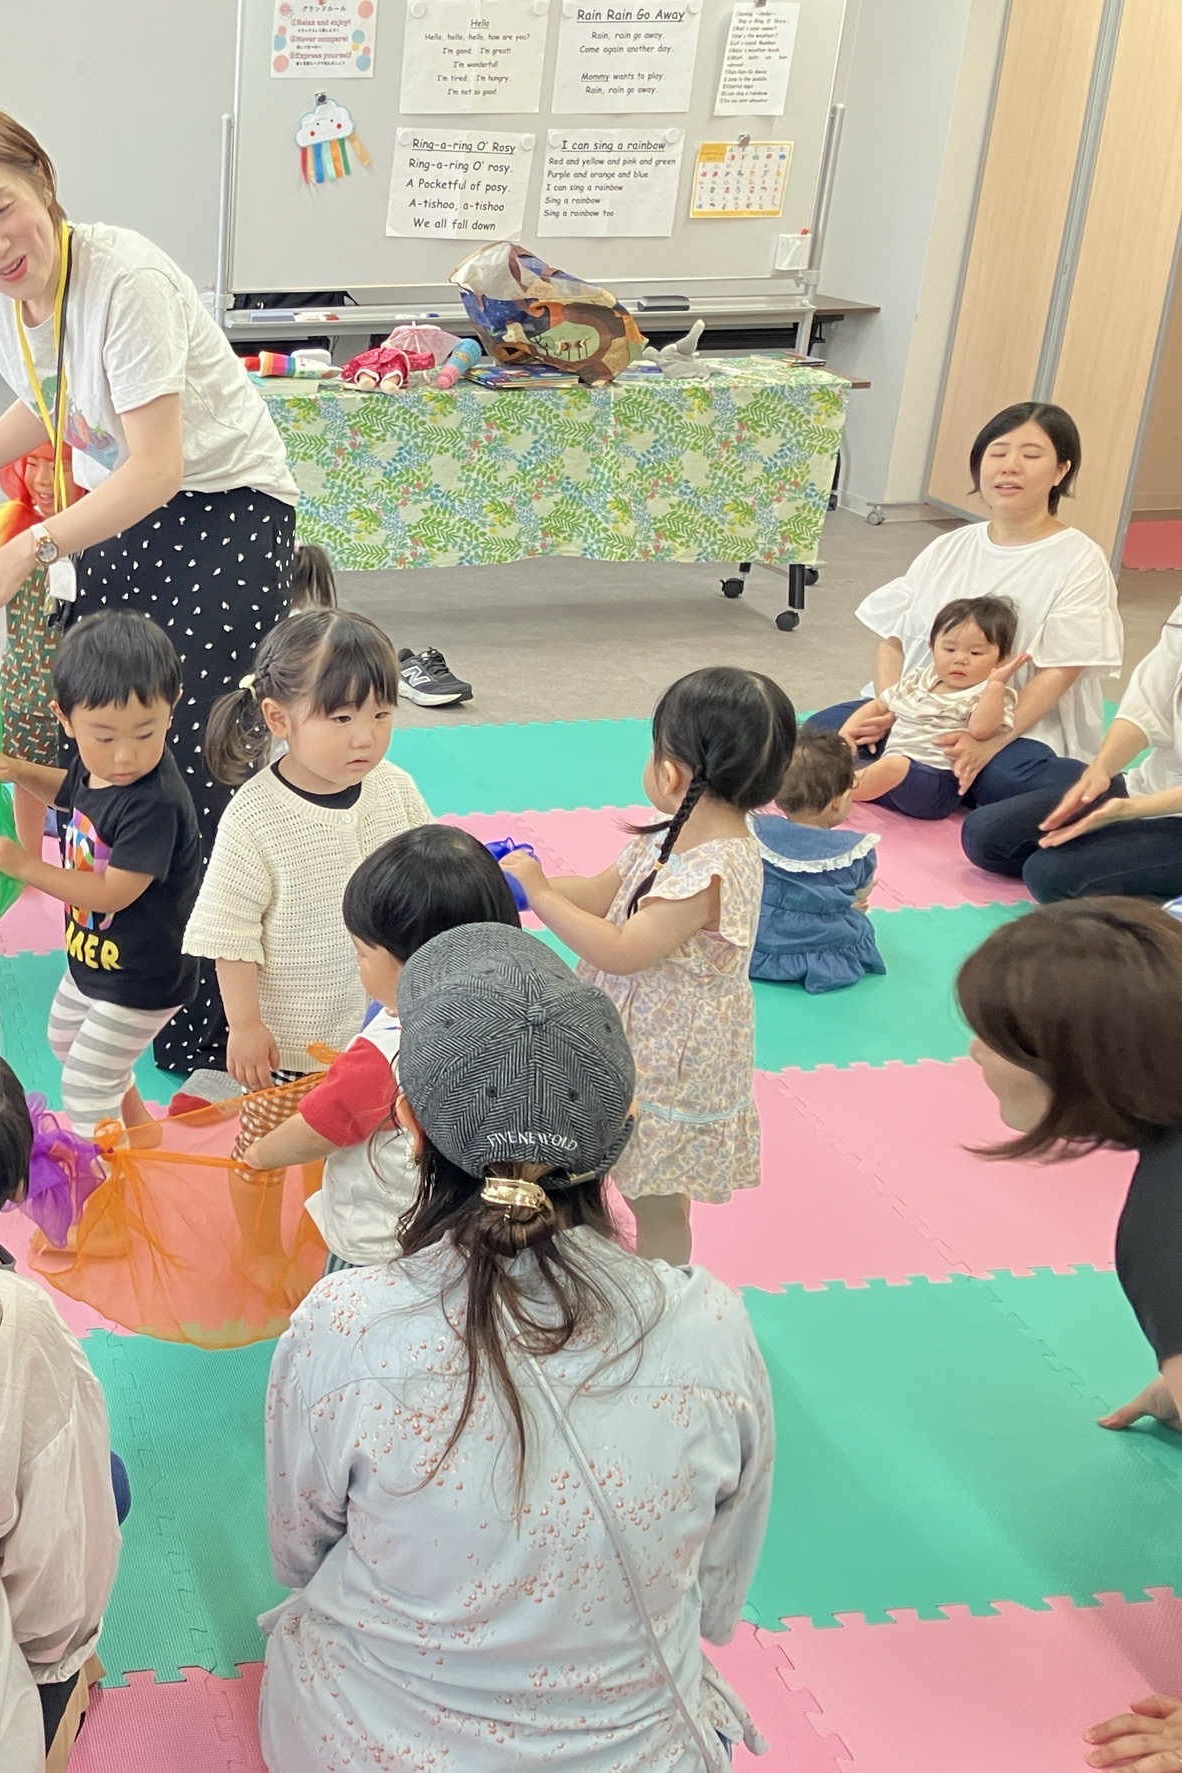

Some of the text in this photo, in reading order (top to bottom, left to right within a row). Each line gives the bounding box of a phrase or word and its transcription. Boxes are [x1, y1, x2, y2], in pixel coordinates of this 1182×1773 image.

[578, 8, 685, 23] Rain Rain Go Away
[471, 19, 489, 27] Hello
[592, 31, 611, 40] Rain,
[615, 31, 631, 39] rain
[579, 45, 600, 53] Come
[603, 45, 624, 55] again
[627, 44, 654, 53] another
[581, 72, 610, 81] Mommy
[613, 72, 634, 80] wants
[637, 72, 645, 80] to
[586, 86, 605, 95] Rain,
[609, 86, 624, 94] rain
[627, 88, 635, 96] go
[412, 138, 473, 153] Ring-a-ring
[492, 142, 516, 155] Rosy
[561, 140, 666, 152] I can sing a rainbow
[409, 158, 469, 173] Ring-a-ring
[488, 164, 513, 175] rosy.
[549, 157, 676, 167] Red and yellow and pink and green
[547, 170, 649, 180] Purple and orange and blue
[406, 178, 510, 195] A Pocketful of posy.
[546, 183, 551, 191] I
[569, 183, 584, 193] sing
[594, 183, 623, 191] rainbow
[409, 198, 505, 211] A-tishoo, a-tishoo
[544, 196, 561, 206] Sing
[571, 196, 601, 204] rainbow
[543, 209, 560, 219] Sing
[570, 209, 599, 217] rainbow
[603, 209, 615, 217] too
[413, 217, 496, 230] We all fall down
